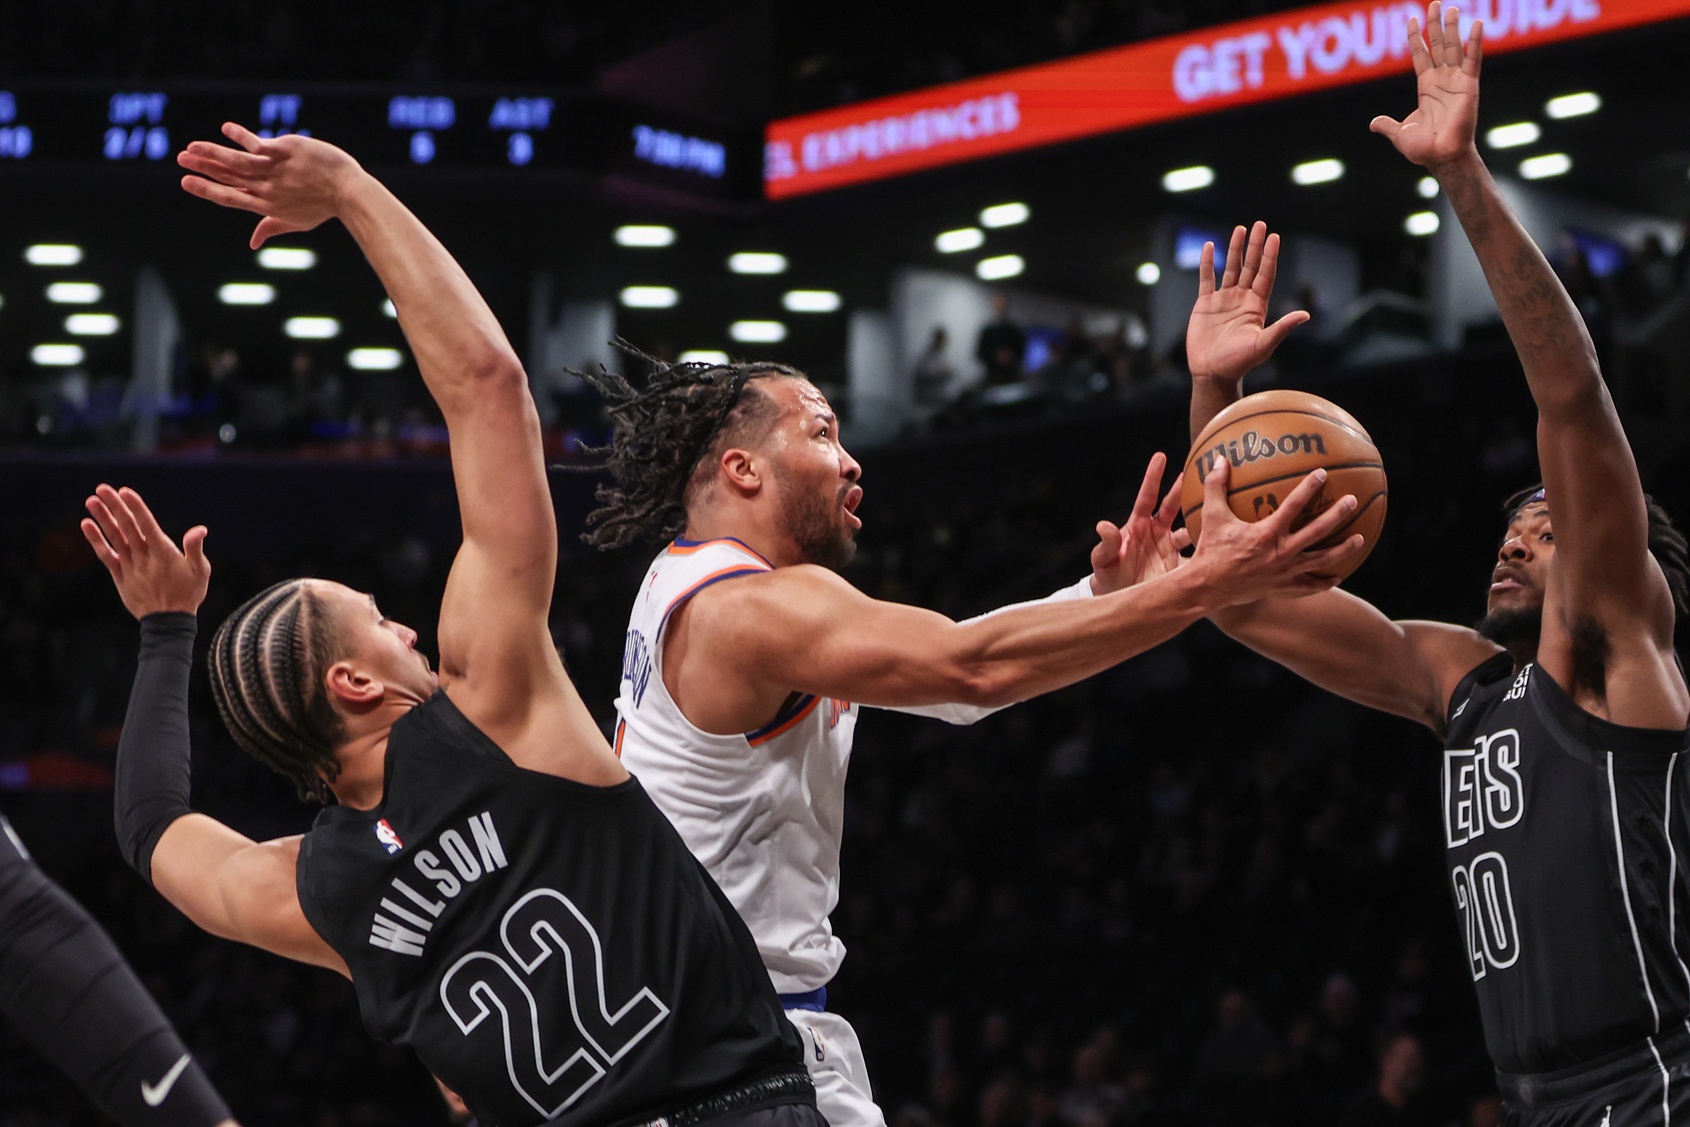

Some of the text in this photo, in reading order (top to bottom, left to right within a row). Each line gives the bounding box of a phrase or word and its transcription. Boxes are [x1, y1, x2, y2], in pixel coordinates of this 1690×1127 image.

[1172, 31, 1271, 103] GET
[1277, 2, 1425, 80] YOUR
[802, 91, 1021, 172] EXPERIENCES
[1195, 431, 1328, 486] Wilson
[369, 811, 508, 957] WILSON
[1452, 851, 1521, 982] 20
[440, 888, 670, 1120] 22
